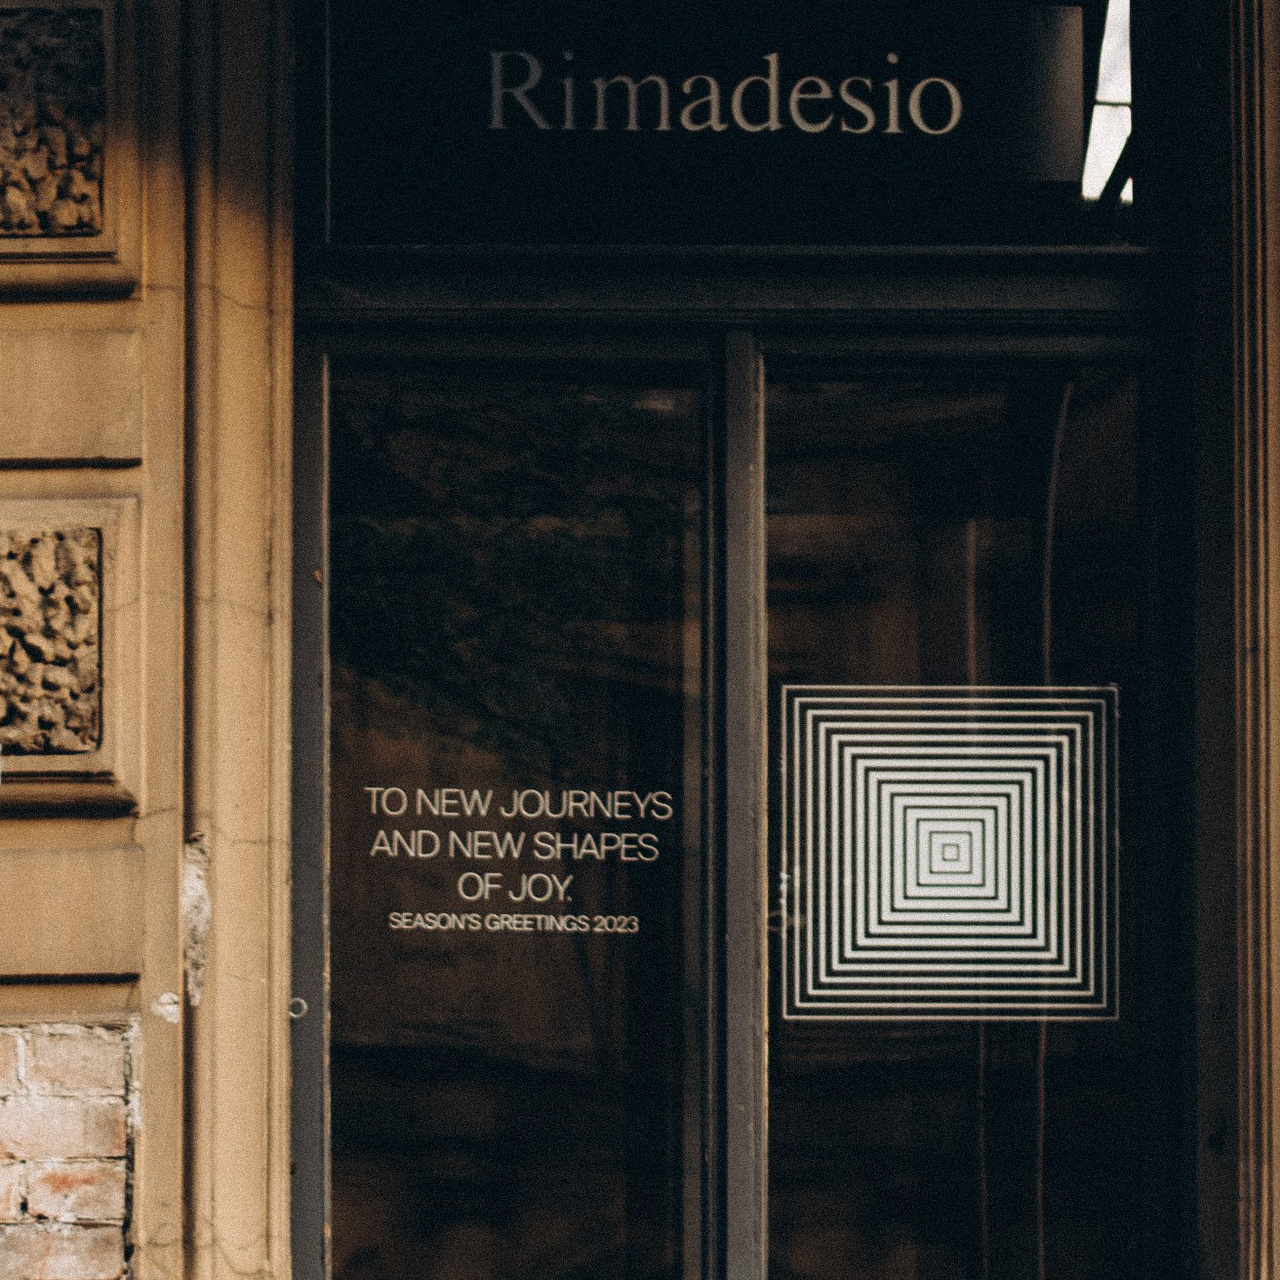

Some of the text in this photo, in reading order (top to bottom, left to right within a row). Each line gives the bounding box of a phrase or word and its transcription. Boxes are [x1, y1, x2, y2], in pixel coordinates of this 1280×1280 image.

[487, 50, 963, 136] Rimadesio
[364, 786, 673, 820] TO NEW JOURNEYS
[370, 829, 659, 862] AND NEW SHAPES
[457, 871, 573, 902] OF JOY.
[389, 912, 639, 933] SEASON'S GREETINGS 2023
